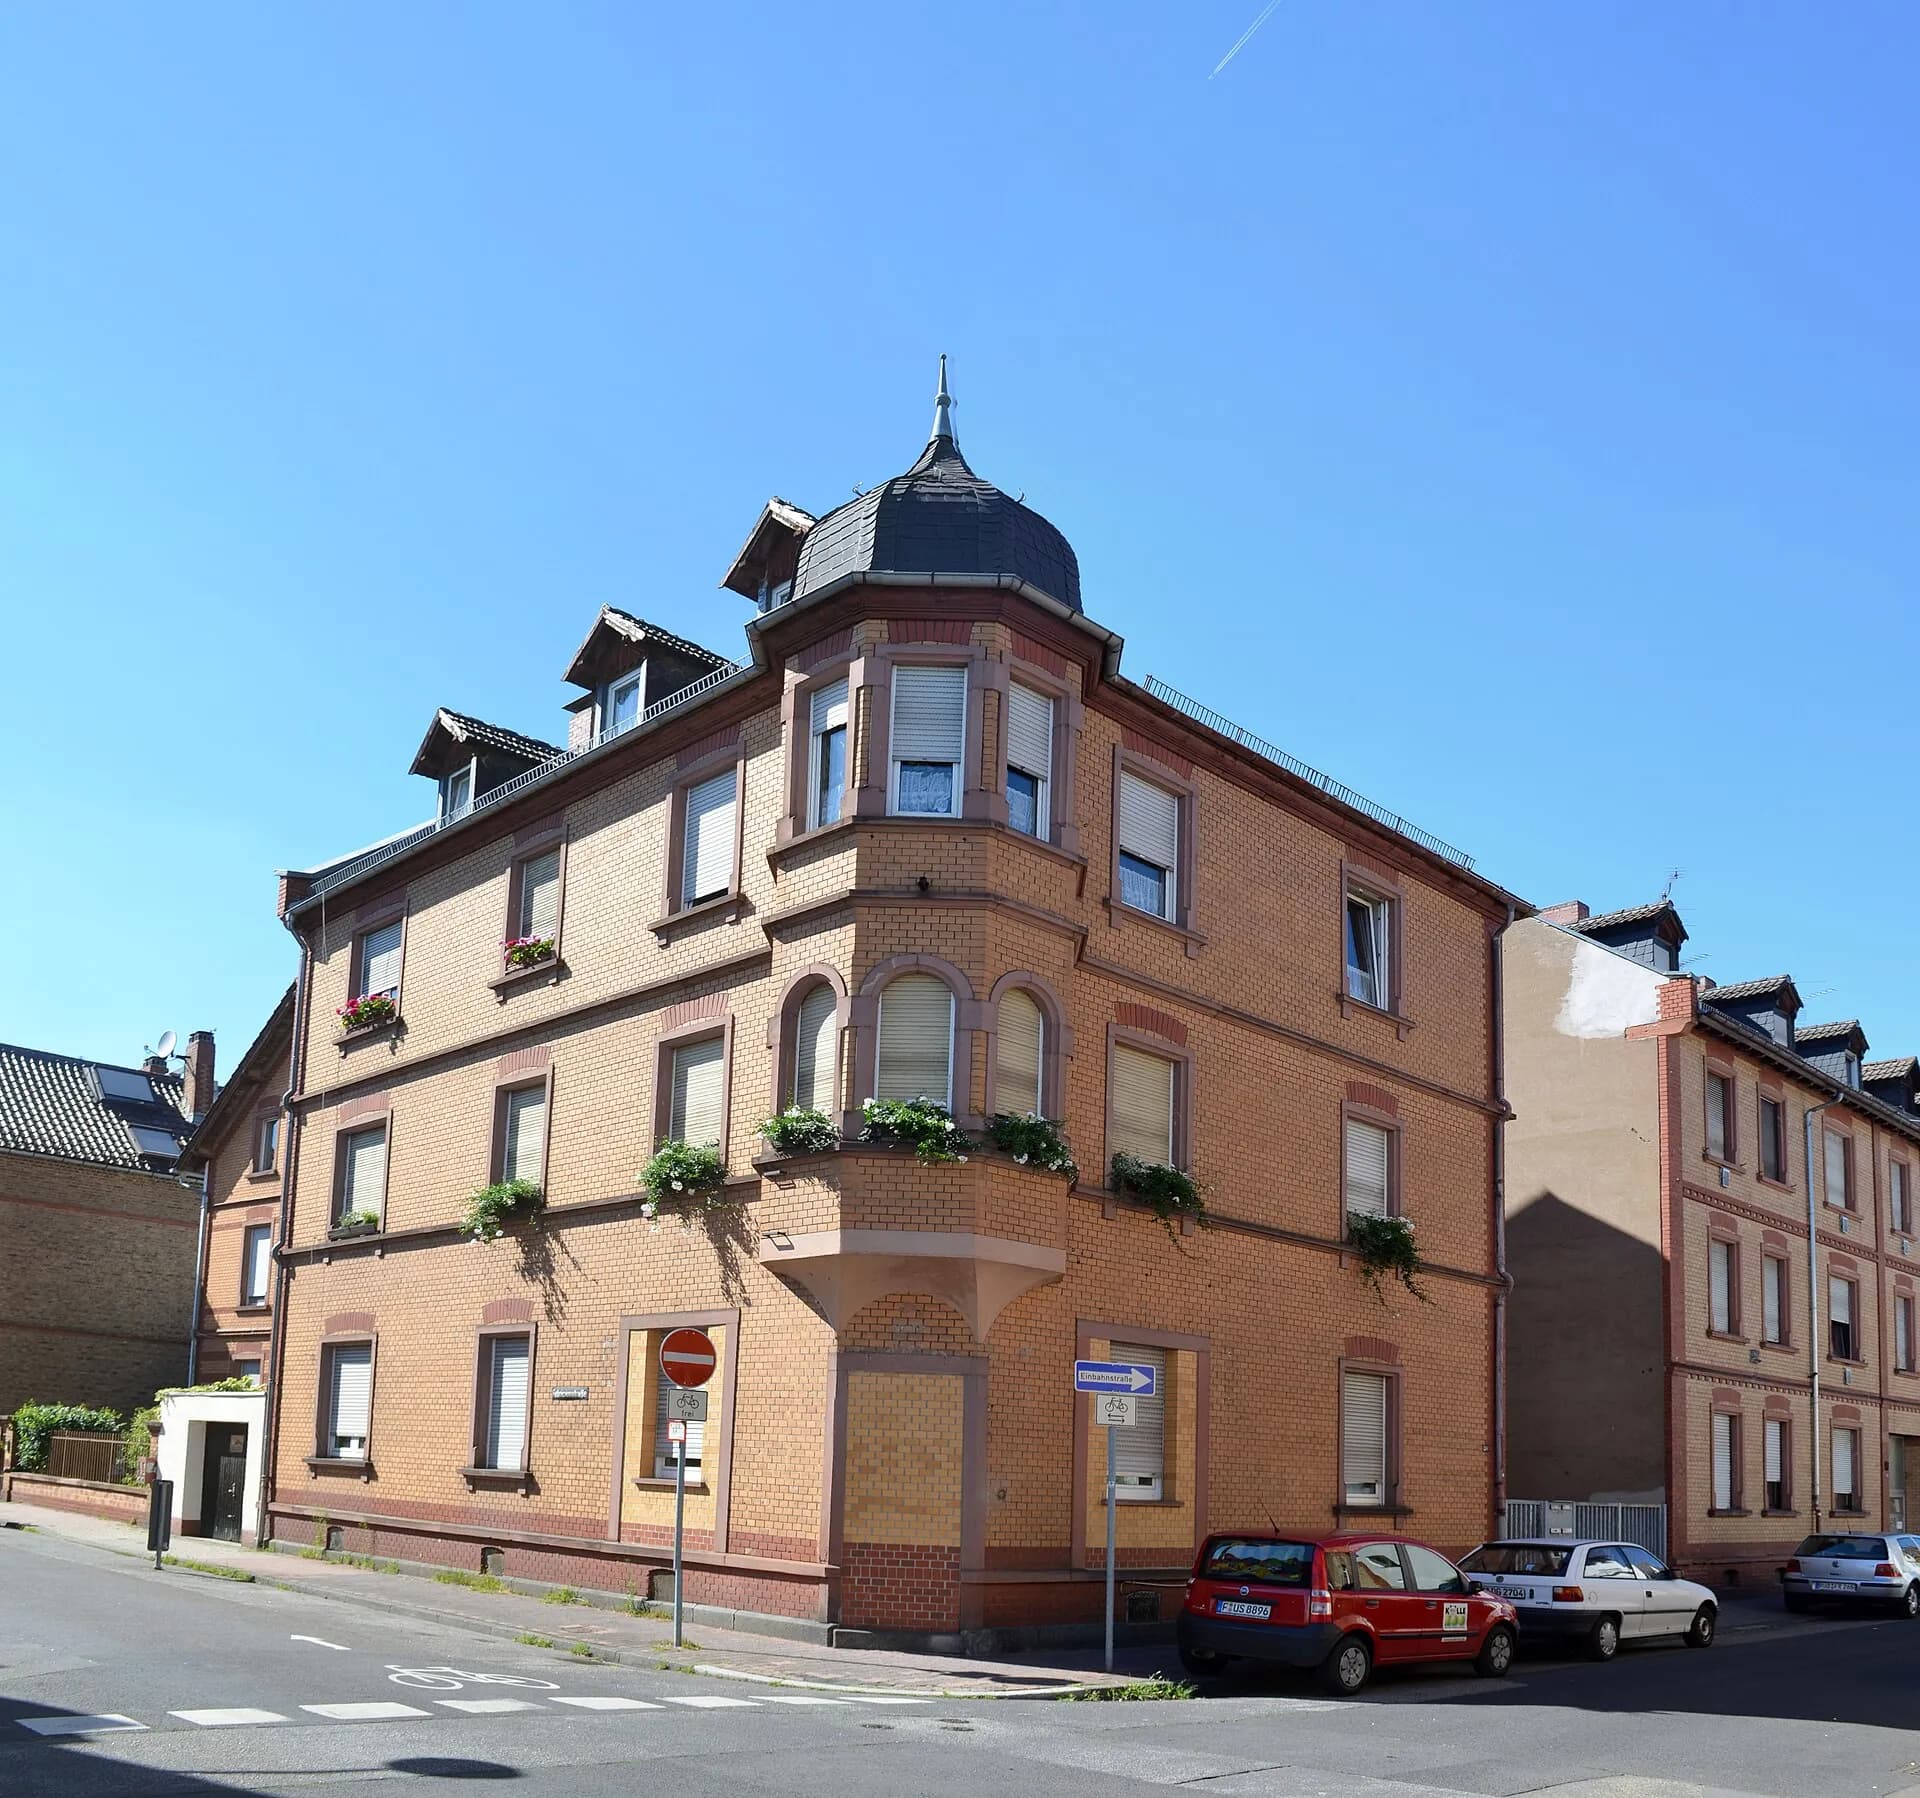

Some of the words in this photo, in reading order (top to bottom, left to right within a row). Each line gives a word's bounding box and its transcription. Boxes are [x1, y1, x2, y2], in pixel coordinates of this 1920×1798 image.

[1080, 1372, 1133, 1383] Einbahnstraße
[681, 1409, 695, 1417] frei
[1502, 1588, 1523, 1597] 2704
[1221, 1602, 1227, 1611] F
[1233, 1604, 1245, 1613] US
[1246, 1605, 1269, 1616] 8896
